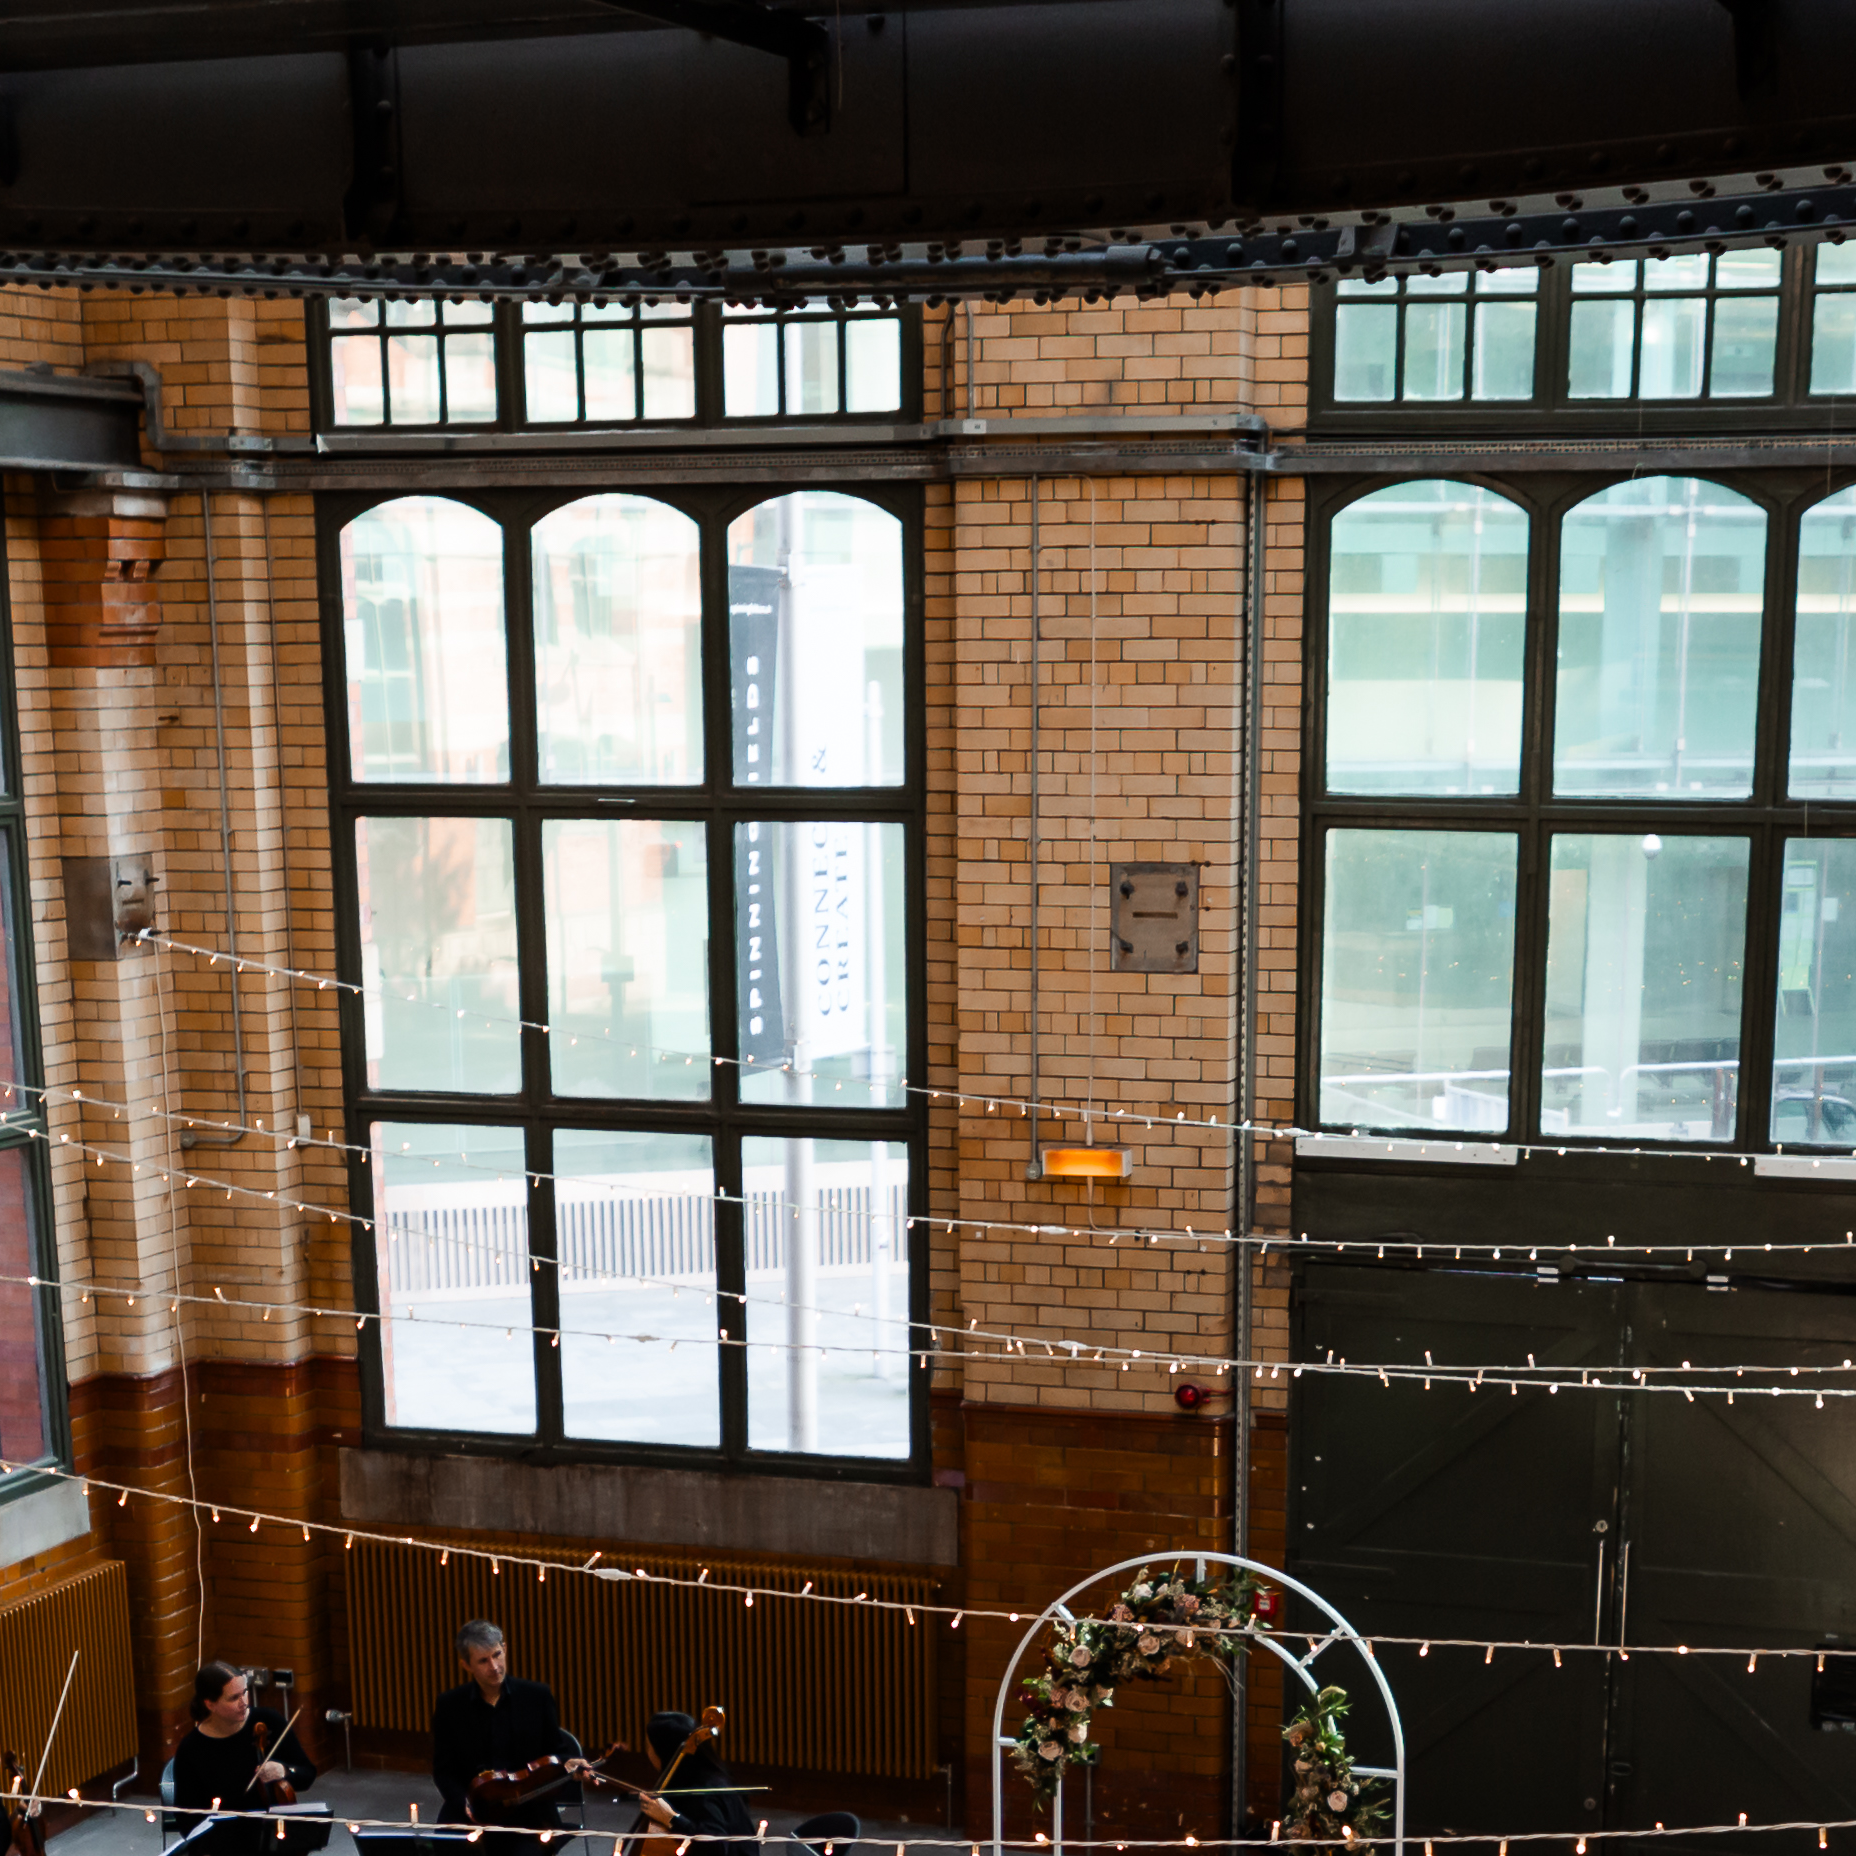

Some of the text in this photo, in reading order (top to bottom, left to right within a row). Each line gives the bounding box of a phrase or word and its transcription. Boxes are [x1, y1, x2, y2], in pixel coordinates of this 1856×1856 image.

[746, 654, 763, 1036] SPINNINGIELDS
[811, 745, 832, 1017] CONNEC &
[834, 835, 850, 1013] CREATE
